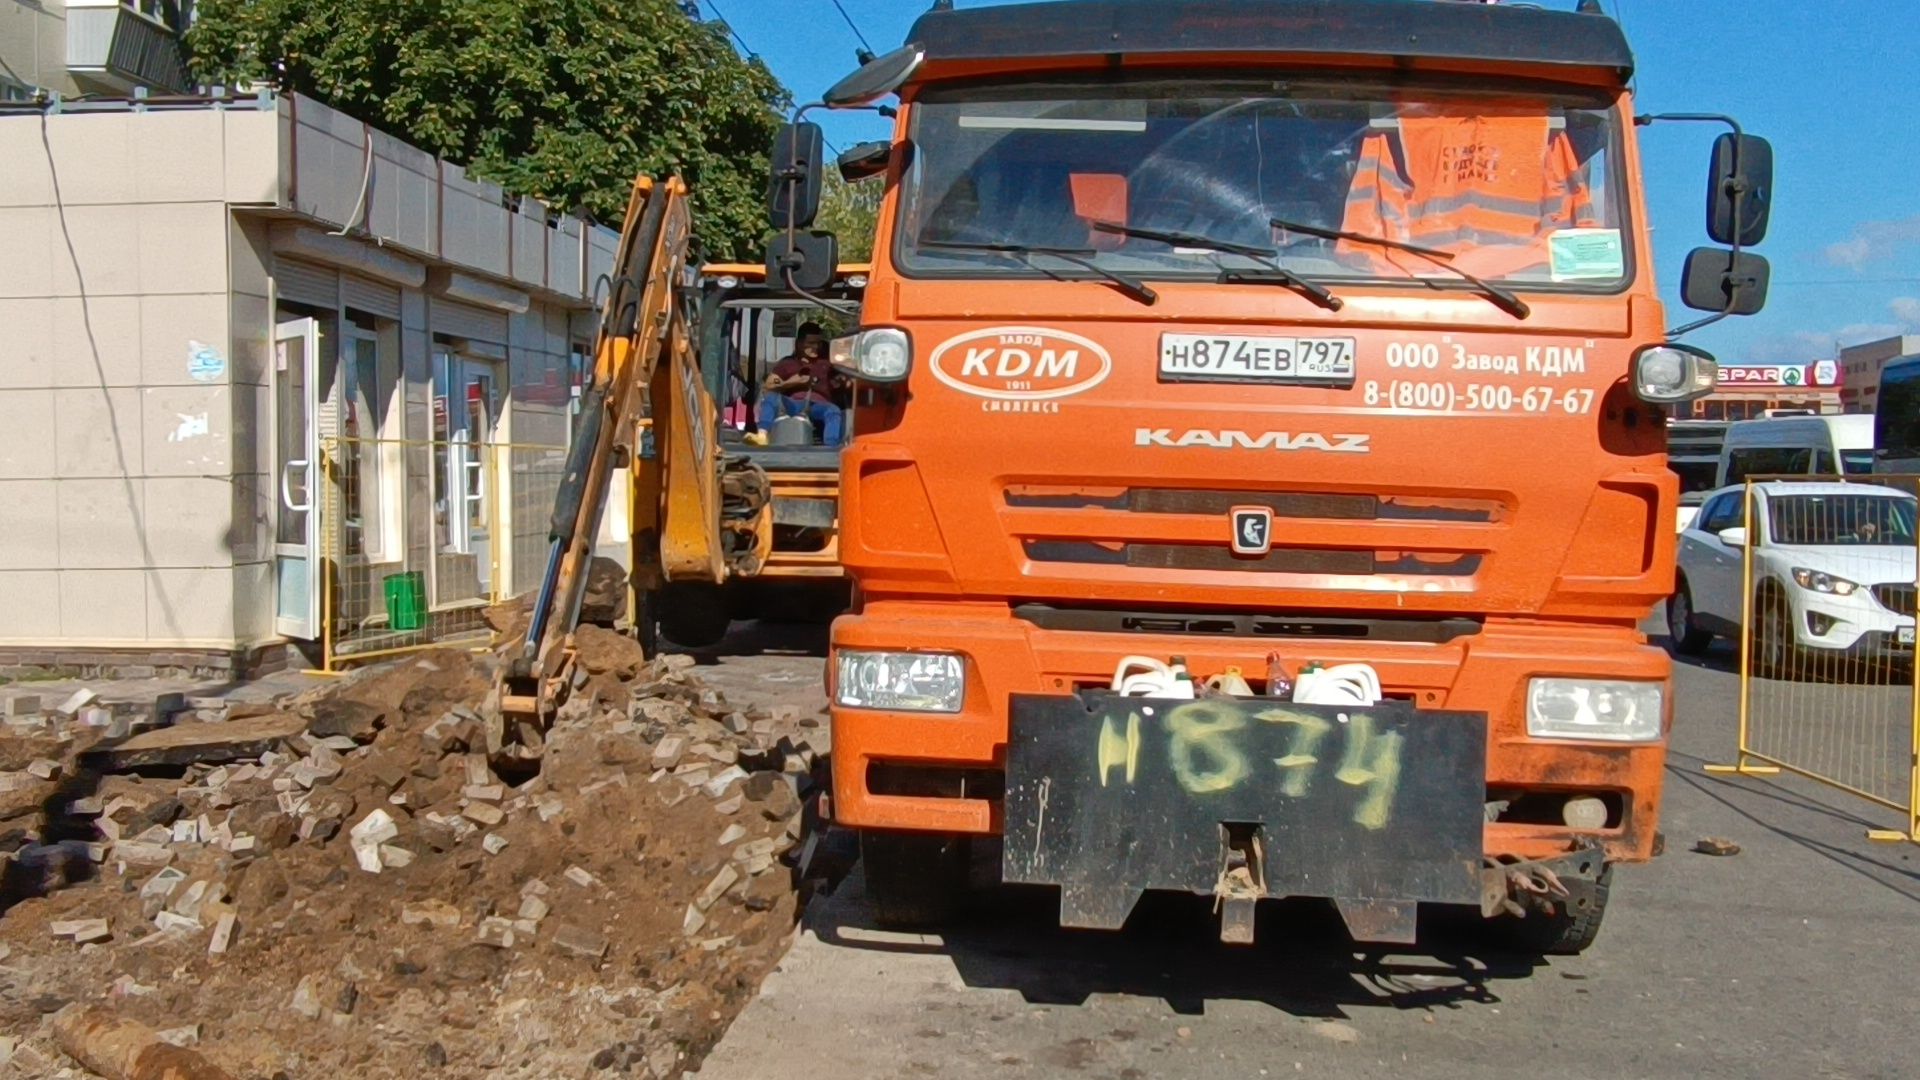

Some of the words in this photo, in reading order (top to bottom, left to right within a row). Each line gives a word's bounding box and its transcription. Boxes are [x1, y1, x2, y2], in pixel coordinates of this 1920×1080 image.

[1000, 335, 1042, 347] ЗАВОД
[1299, 341, 1345, 365] 797
[1386, 342, 1439, 369] ООО
[961, 348, 1079, 378] KDM
[1308, 363, 1331, 373] RUS
[1717, 368, 1779, 381] SPAR
[1006, 381, 1031, 390] 1911
[1363, 379, 1594, 414] 8-(800)-500-67-67
[981, 401, 1059, 413] СМОЛЕНСК
[1135, 428, 1370, 452] KAMAZ
